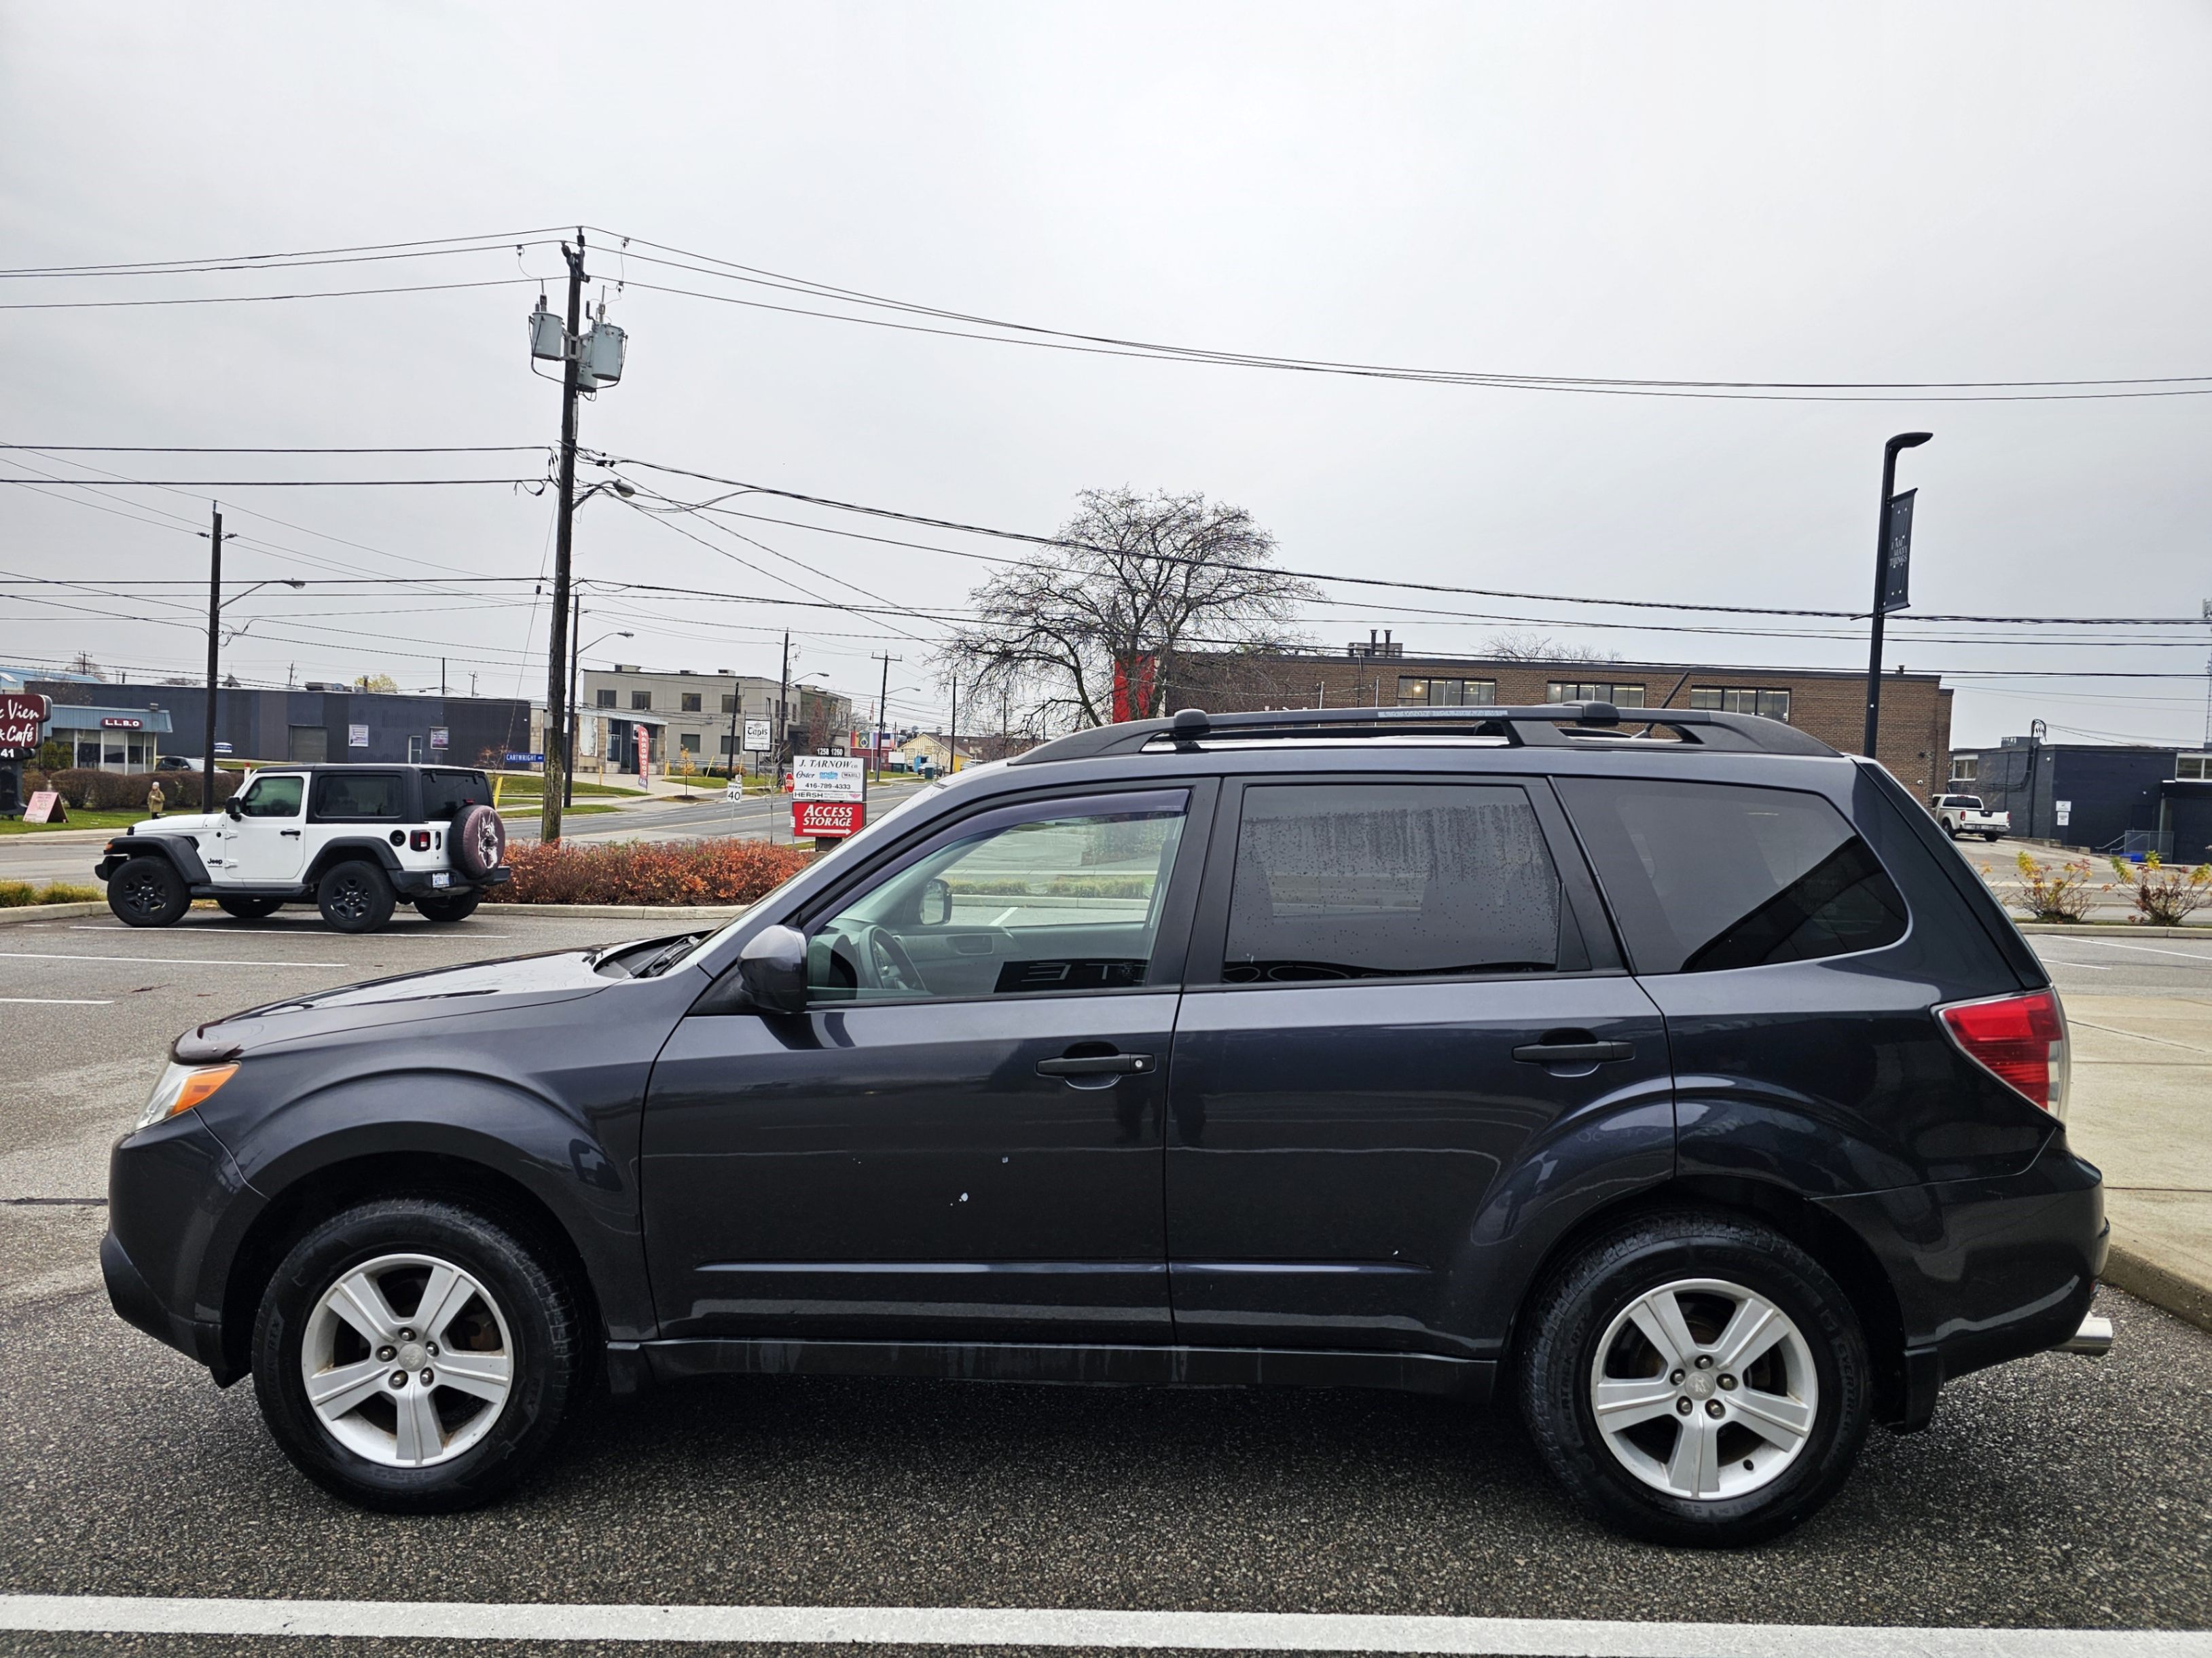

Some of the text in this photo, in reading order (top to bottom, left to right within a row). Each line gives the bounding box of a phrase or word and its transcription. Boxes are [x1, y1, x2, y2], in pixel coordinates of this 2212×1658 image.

[7, 699, 39, 720] Vien
[6, 723, 35, 747] Café
[747, 726, 768, 737] Tapis
[810, 760, 852, 769] TARNOW
[796, 771, 815, 779] Oster
[728, 791, 741, 800] 40
[803, 805, 852, 817] ACCESS
[803, 817, 852, 826] STORAGE
